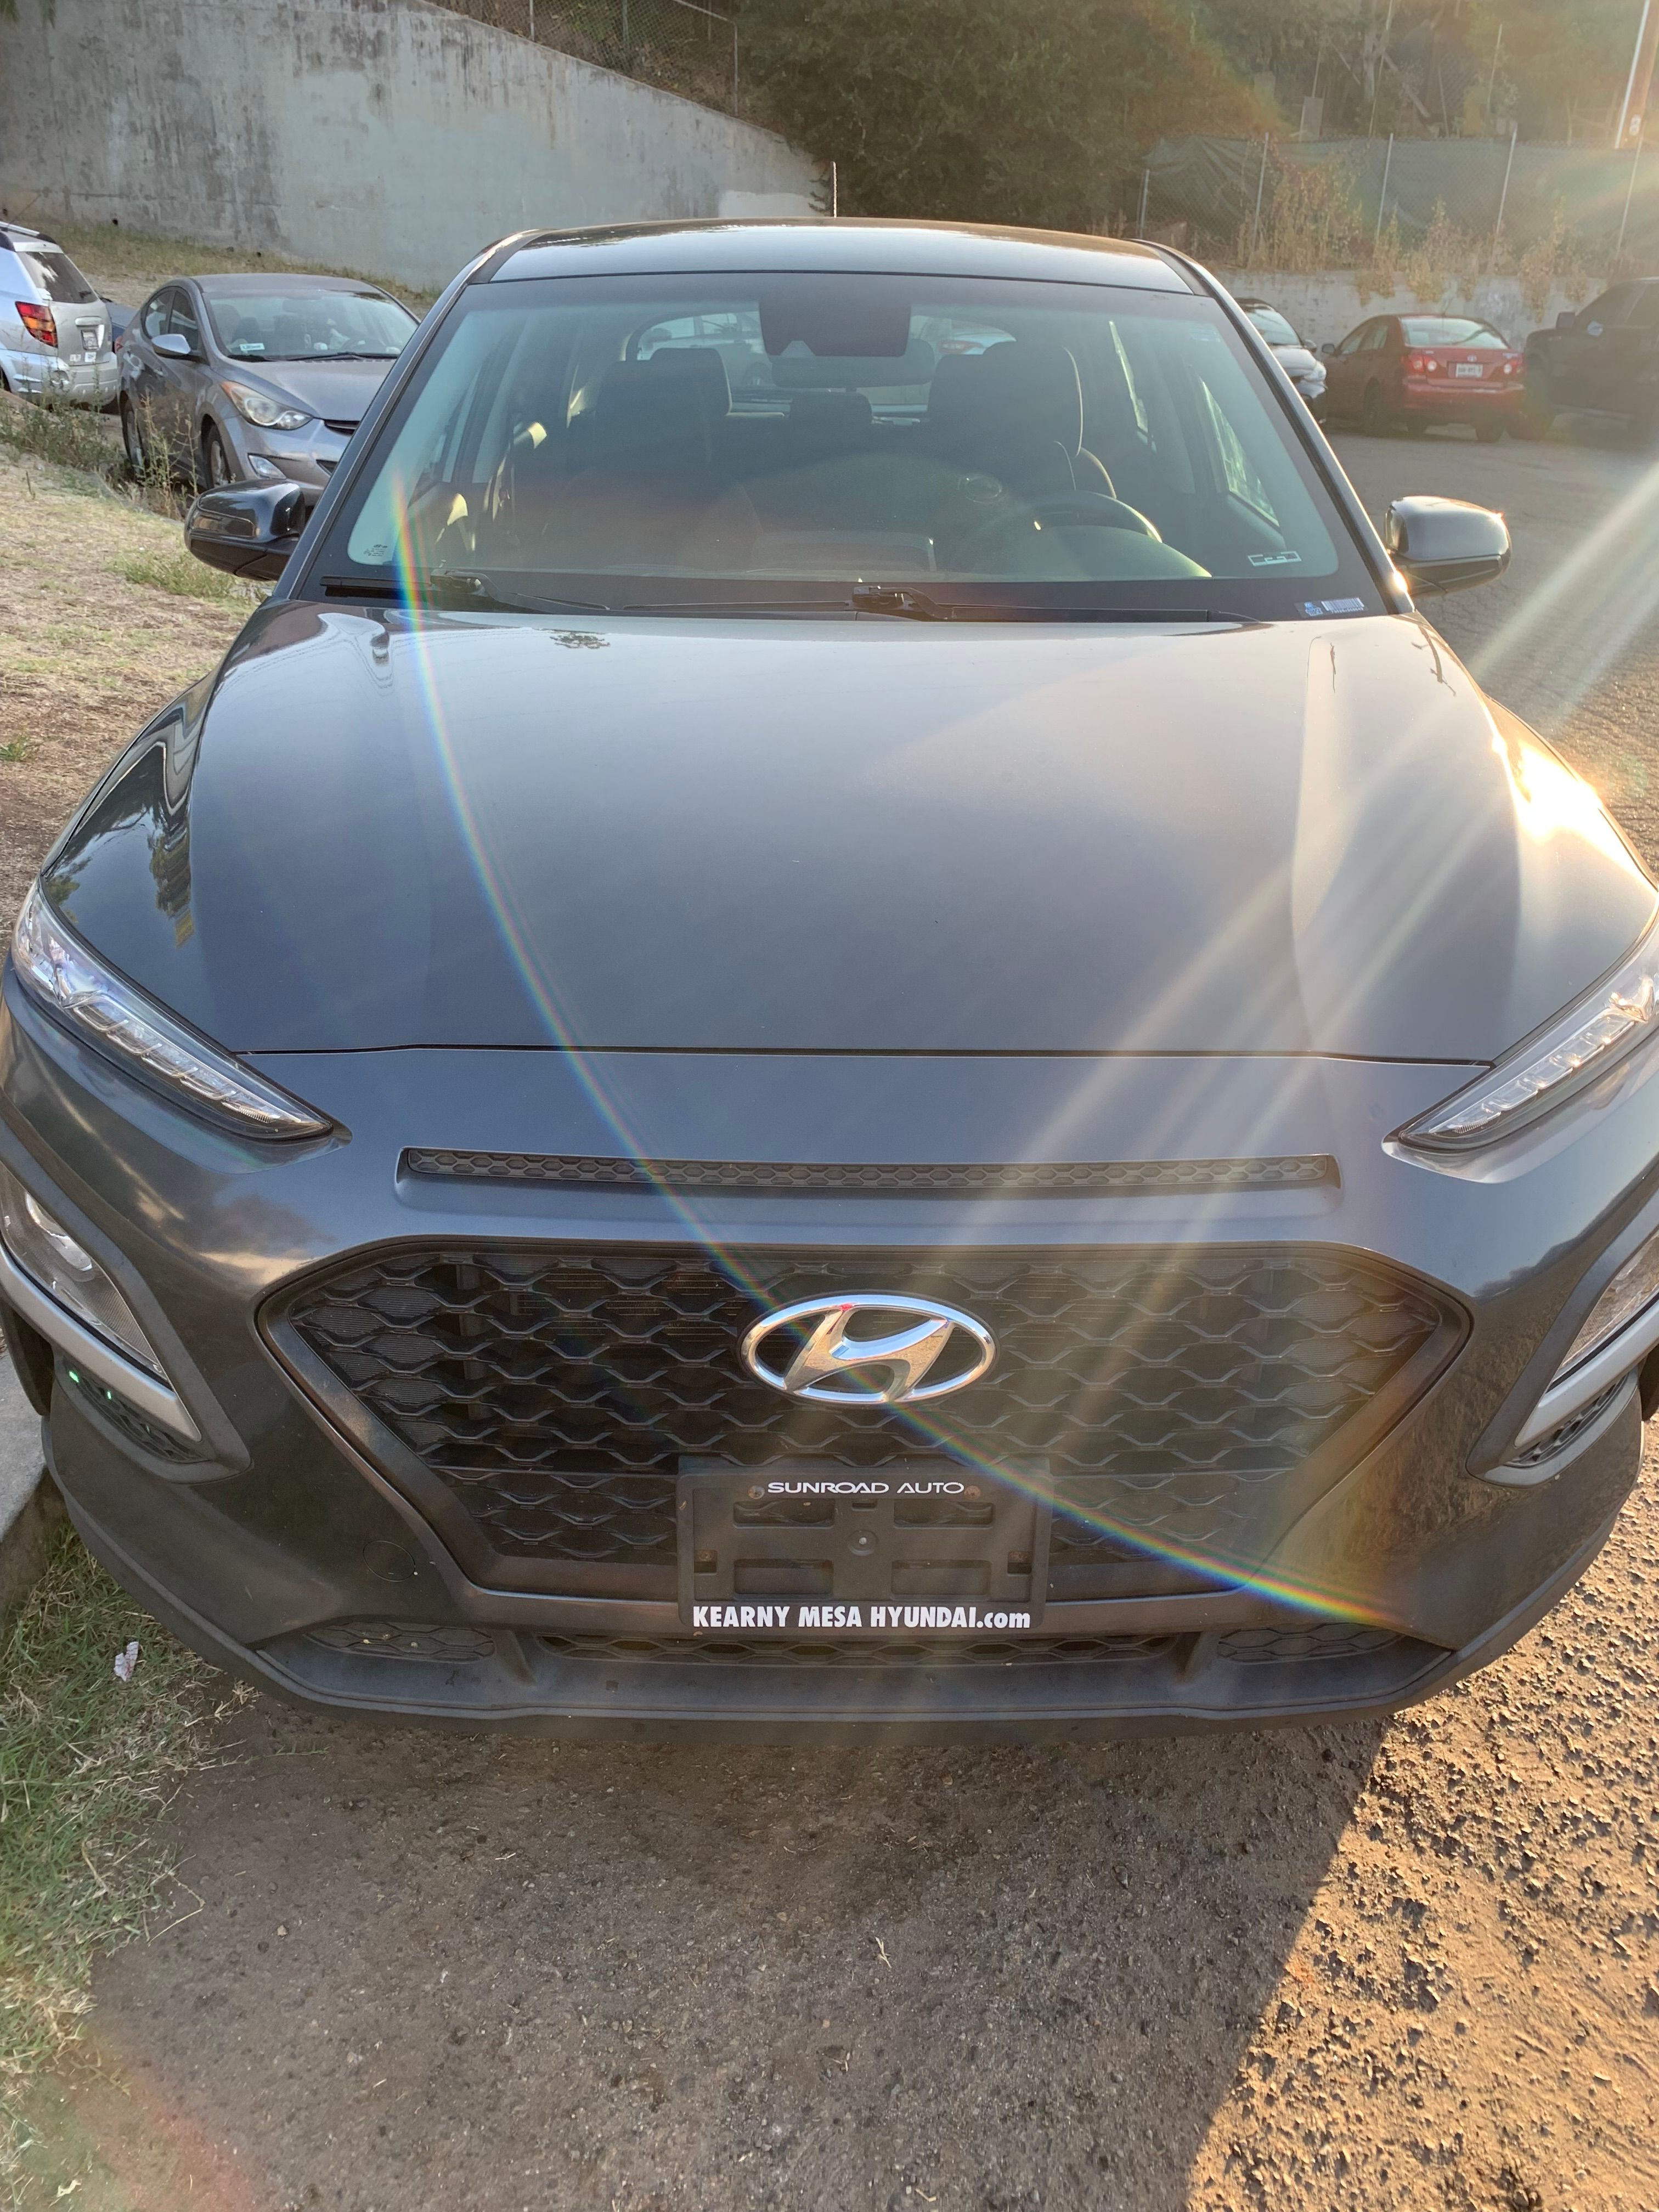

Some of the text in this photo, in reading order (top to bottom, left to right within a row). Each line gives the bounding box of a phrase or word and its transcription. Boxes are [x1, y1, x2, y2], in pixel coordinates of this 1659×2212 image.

[768, 1482, 964, 1493] SUNROAD AUTO
[693, 1606, 1030, 1628] KEARNY MESA HYUNDAI.com
